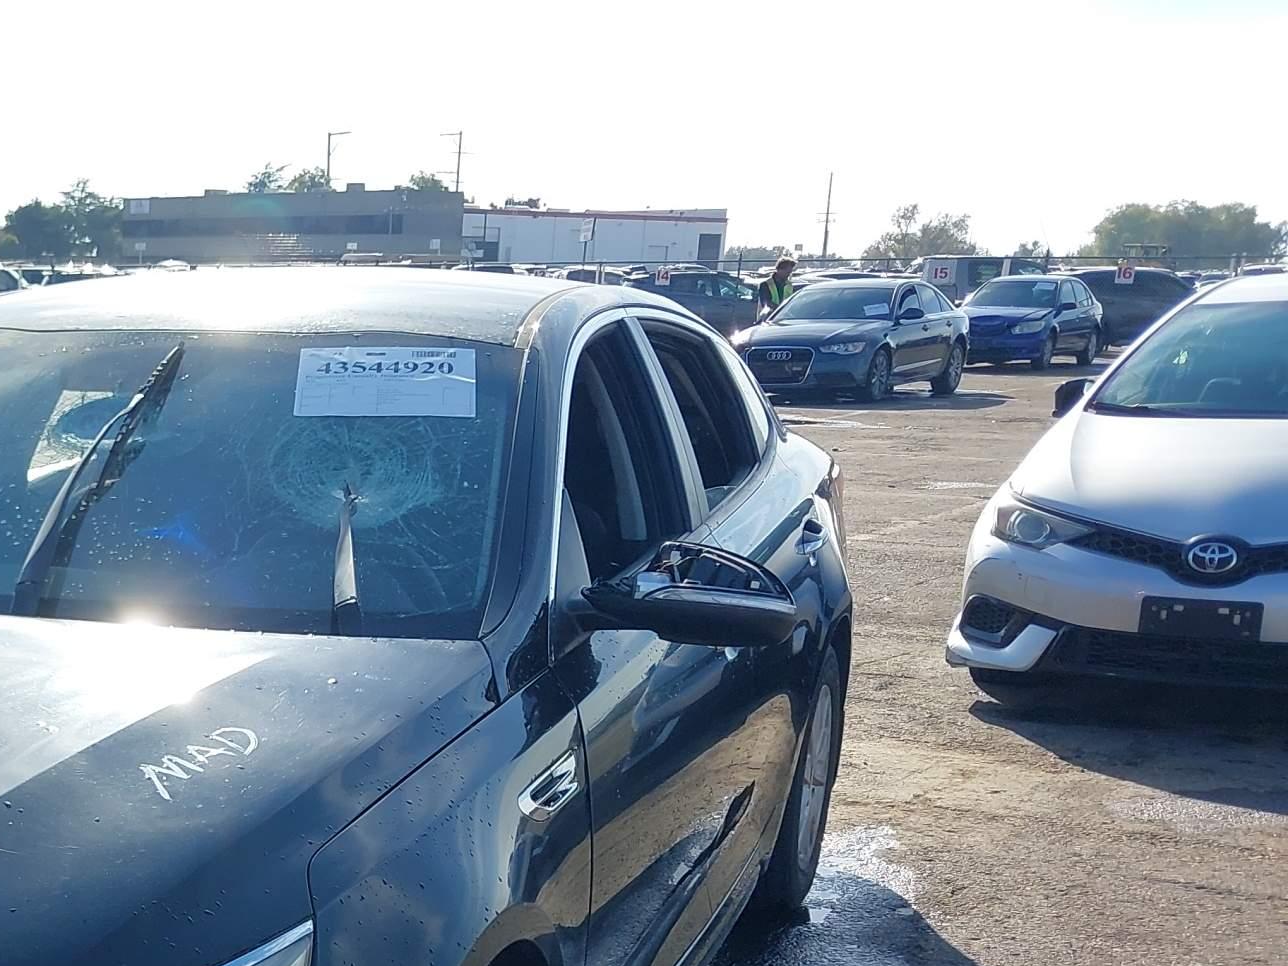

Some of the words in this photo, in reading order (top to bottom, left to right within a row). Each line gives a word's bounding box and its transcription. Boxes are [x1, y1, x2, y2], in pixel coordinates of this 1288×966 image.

[657, 270, 669, 281] 14
[933, 266, 949, 279] 15
[1117, 267, 1132, 279] 16
[317, 361, 454, 375] 43544920
